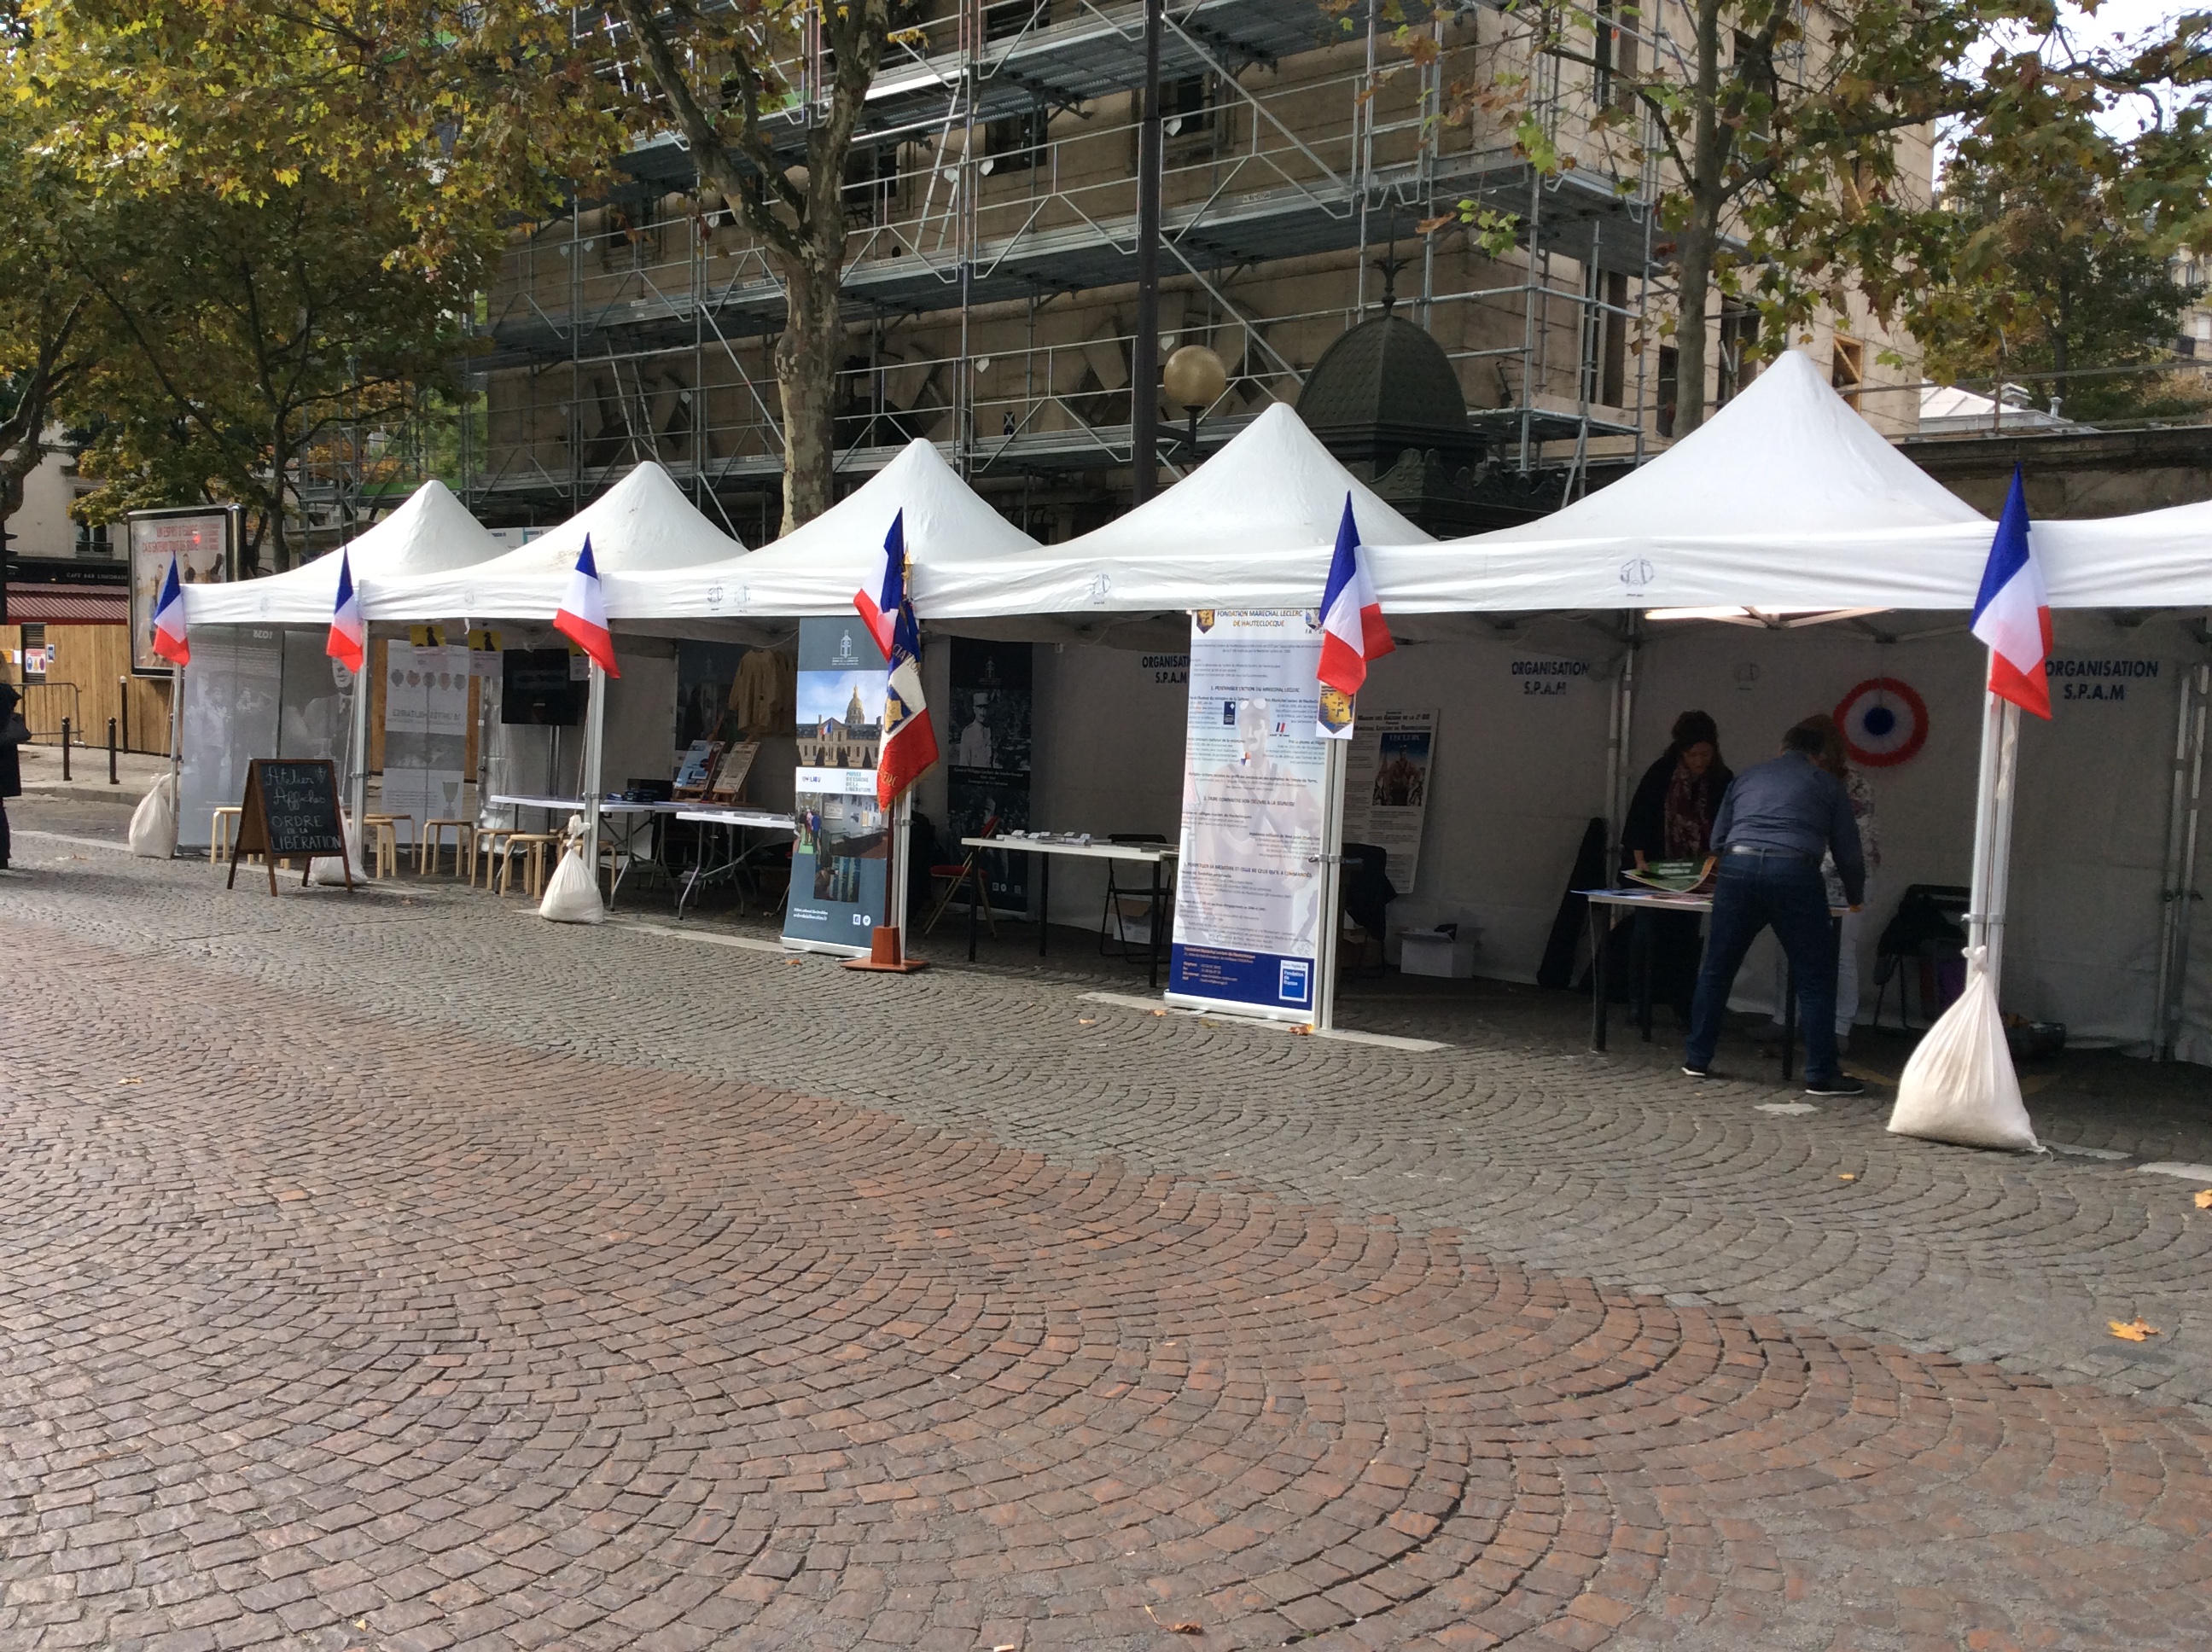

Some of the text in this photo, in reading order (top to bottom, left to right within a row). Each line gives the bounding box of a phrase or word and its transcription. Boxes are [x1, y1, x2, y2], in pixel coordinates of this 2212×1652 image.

[1142, 655, 1190, 668] ORGANISATI
[1511, 661, 1590, 675] ORGANISATION
[2045, 660, 2158, 678] ORGANISATION
[1155, 672, 1187, 683] S.P.A.M
[2064, 683, 2124, 700] S.P.A.M
[265, 766, 315, 786] Atelier
[271, 815, 323, 828] ORDRE
